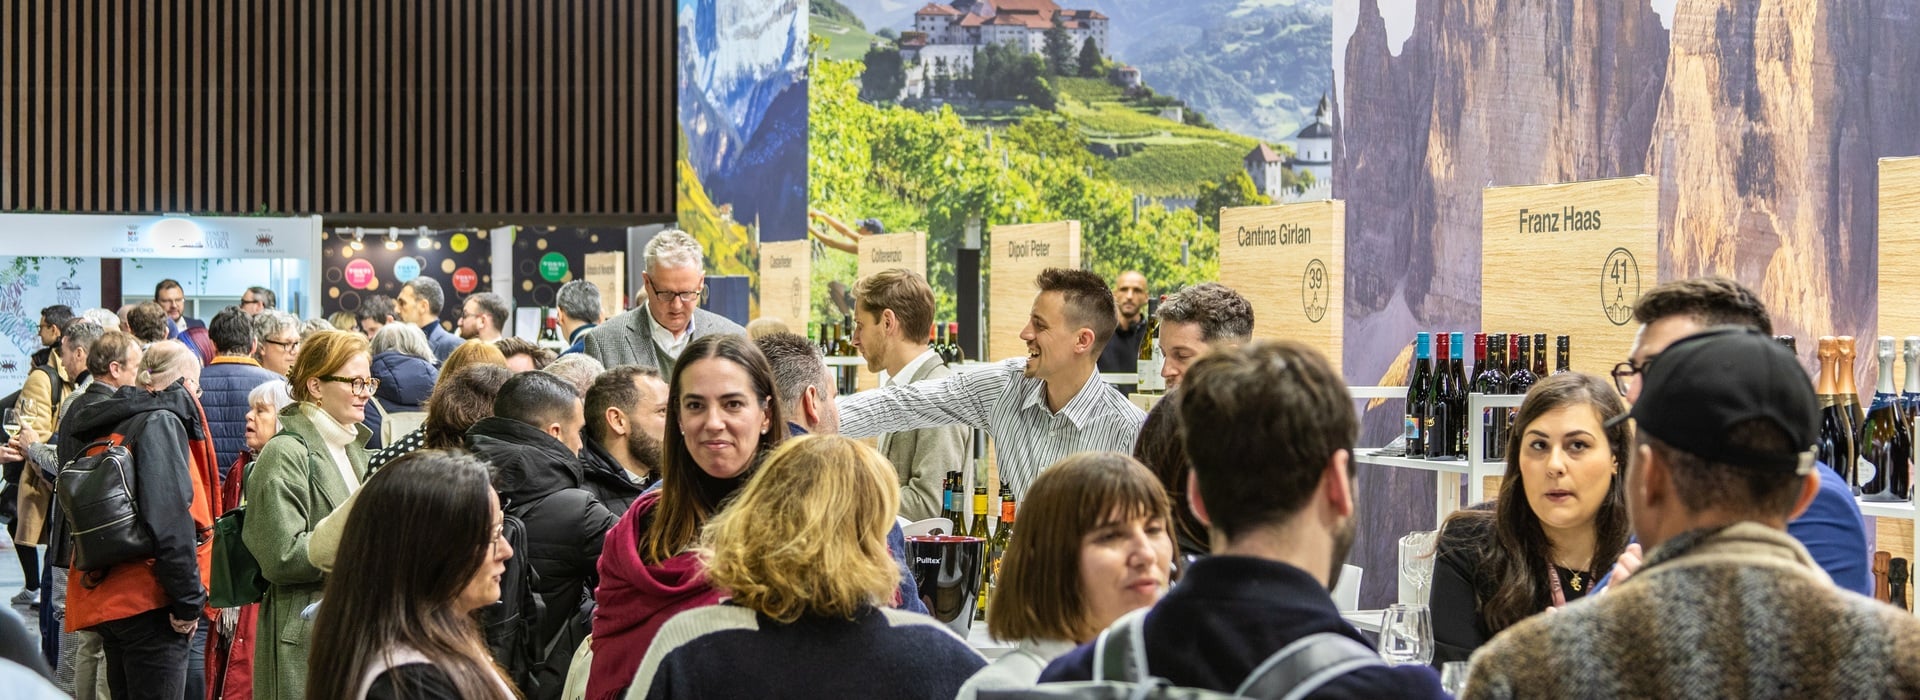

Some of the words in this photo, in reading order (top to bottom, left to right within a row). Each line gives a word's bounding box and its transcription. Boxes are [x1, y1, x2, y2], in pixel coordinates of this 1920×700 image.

[1519, 208, 1559, 234] Franz
[1563, 205, 1602, 232] Haas
[1237, 224, 1277, 248] Cantina
[1279, 222, 1312, 246] Girlan
[871, 247, 903, 263] Colterenzio
[1008, 240, 1030, 262] Dipoli
[1031, 239, 1050, 257] Peter
[1308, 267, 1323, 290] 39
[1610, 258, 1627, 285] 41
[1313, 290, 1319, 303] A
[1616, 287, 1624, 301] A
[916, 556, 941, 564] Pulltex
